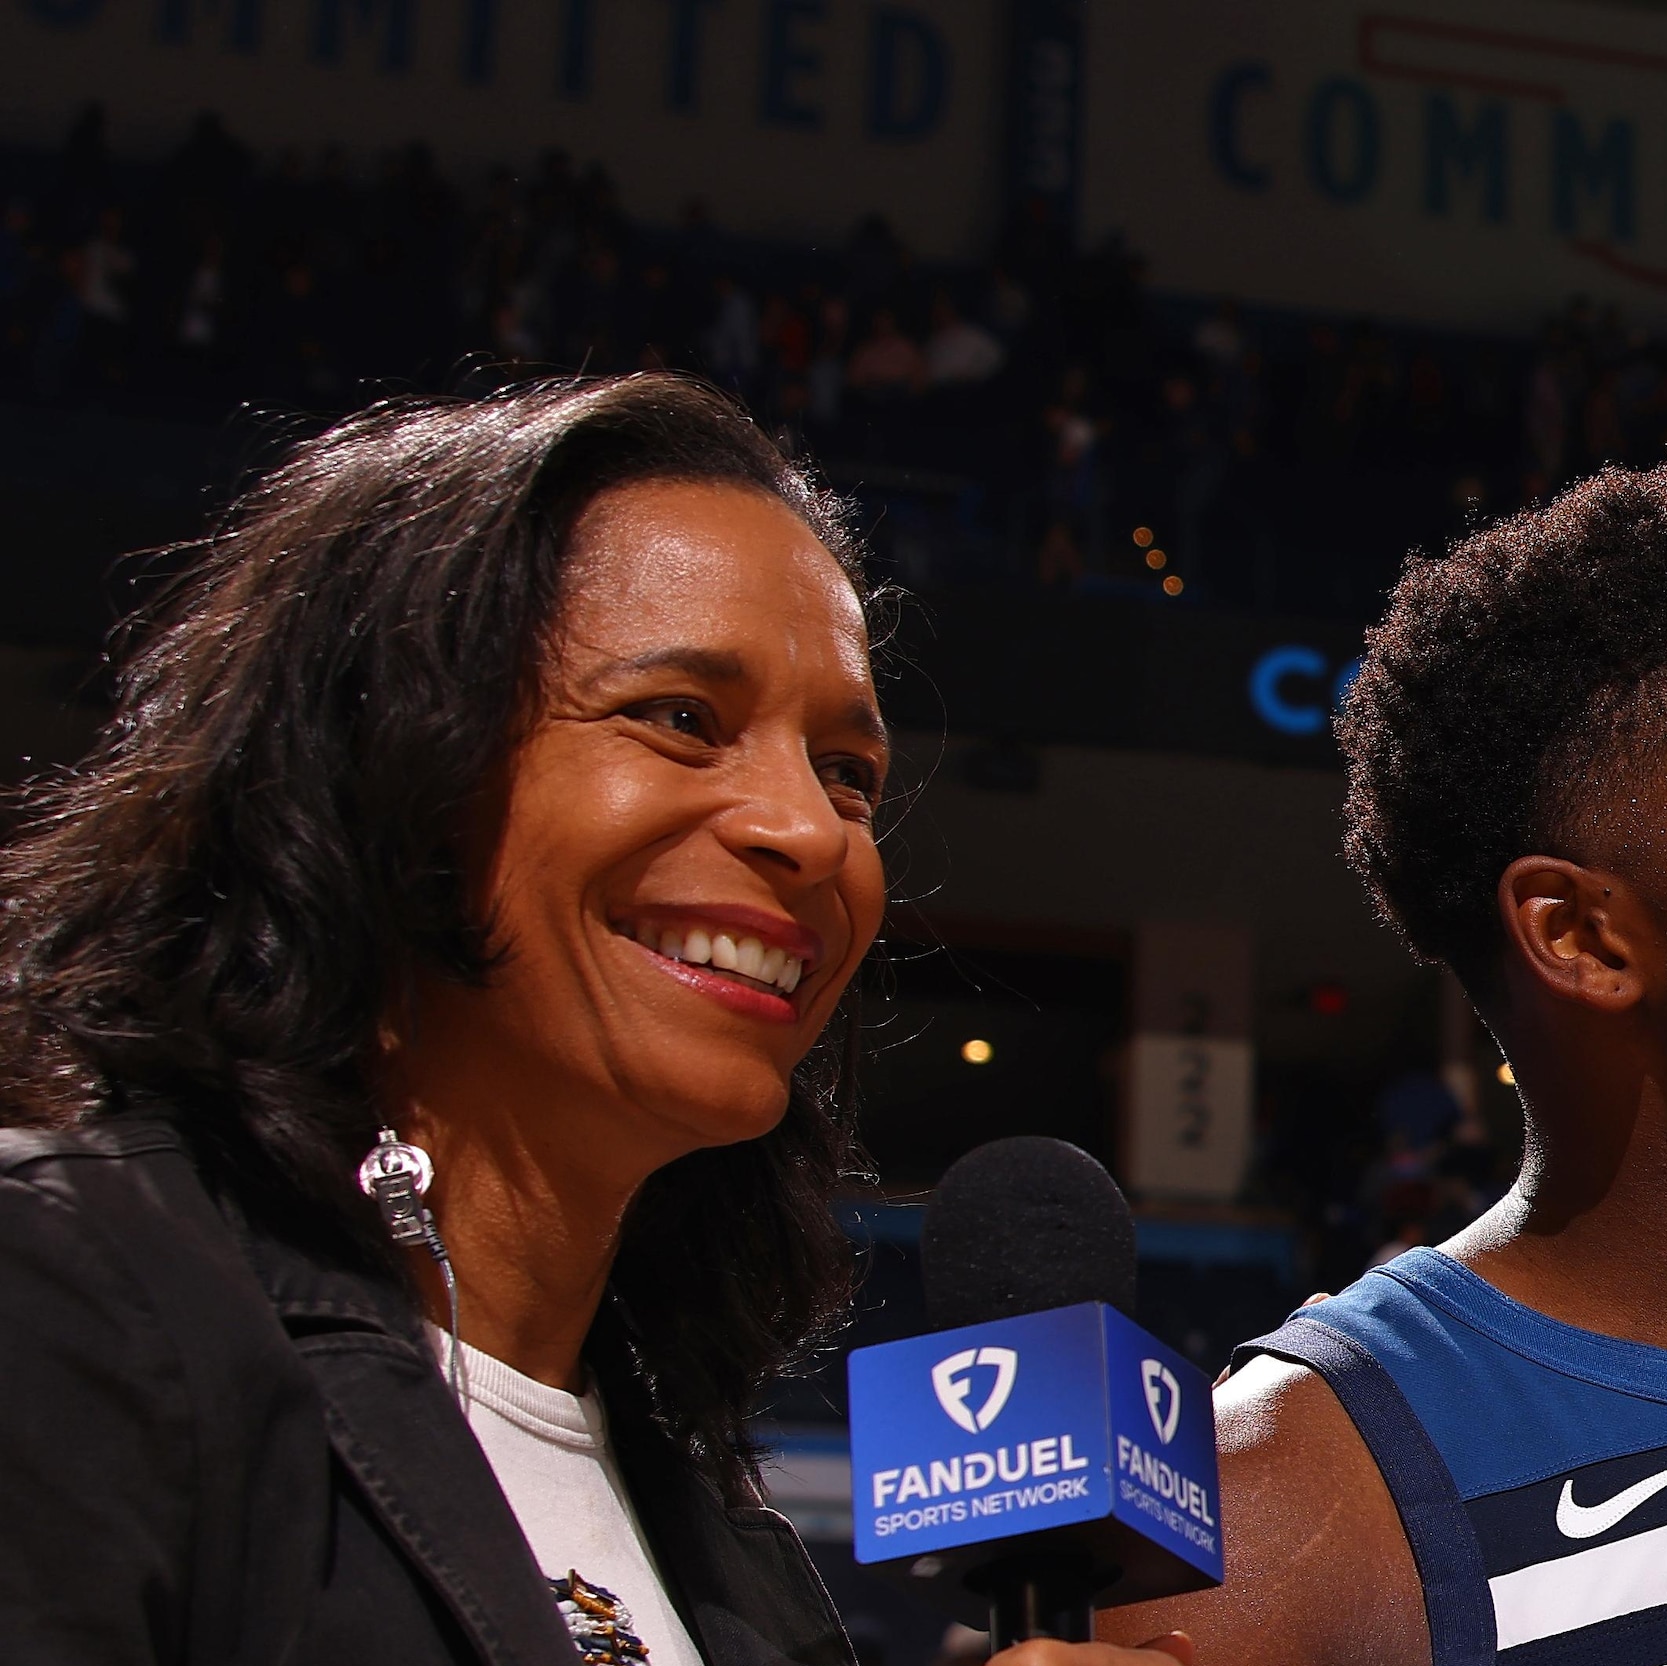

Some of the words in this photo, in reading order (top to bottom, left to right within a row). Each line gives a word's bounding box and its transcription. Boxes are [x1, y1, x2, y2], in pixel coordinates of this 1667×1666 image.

[872, 1434, 1089, 1508] FANDUEL
[874, 1500, 968, 1536] SPORTS
[972, 1476, 1089, 1518] NETWORK
[1117, 1434, 1215, 1527] FANDUEL
[1119, 1479, 1164, 1522] SPORTS
[1163, 1504, 1216, 1554] NETWORK
